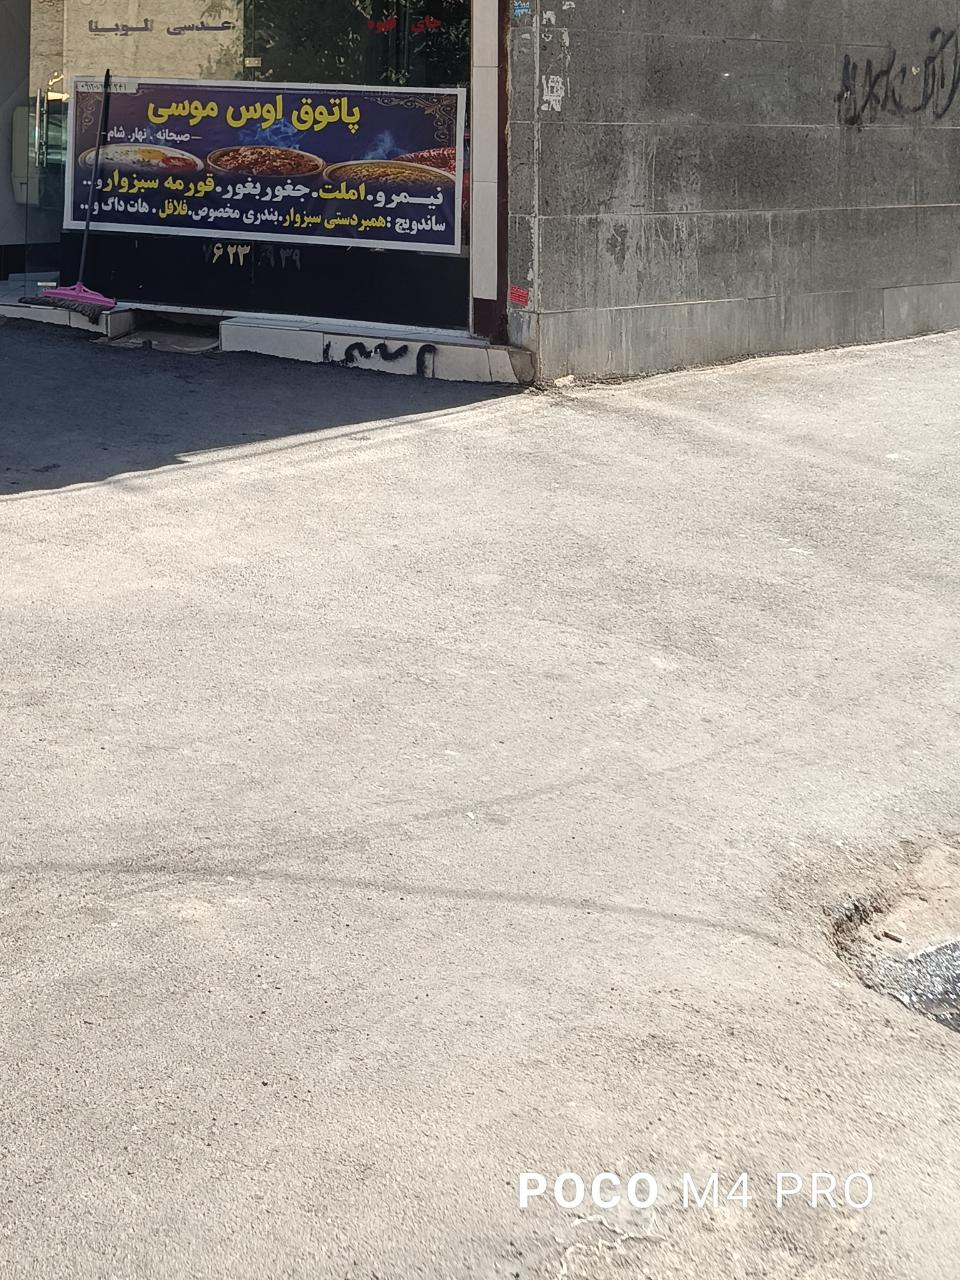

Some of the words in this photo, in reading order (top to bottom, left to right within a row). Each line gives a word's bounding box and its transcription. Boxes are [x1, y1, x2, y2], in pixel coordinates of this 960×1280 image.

[147, 98, 219, 126] موسی
[226, 94, 283, 129] اوس
[291, 96, 361, 134] پاتوق
[107, 125, 125, 140] شام
[156, 128, 190, 142] صبحانه
[102, 169, 159, 194] سبزوار
[319, 181, 366, 201] املت
[101, 196, 125, 212] داگ
[126, 197, 149, 213] هات
[373, 186, 444, 209] نیمرو
[158, 198, 188, 219] فلافل
[191, 203, 240, 222] مخصوص
[242, 207, 279, 225] بندری
[283, 207, 322, 228] سبزوار
[394, 214, 446, 235] ساندویچ
